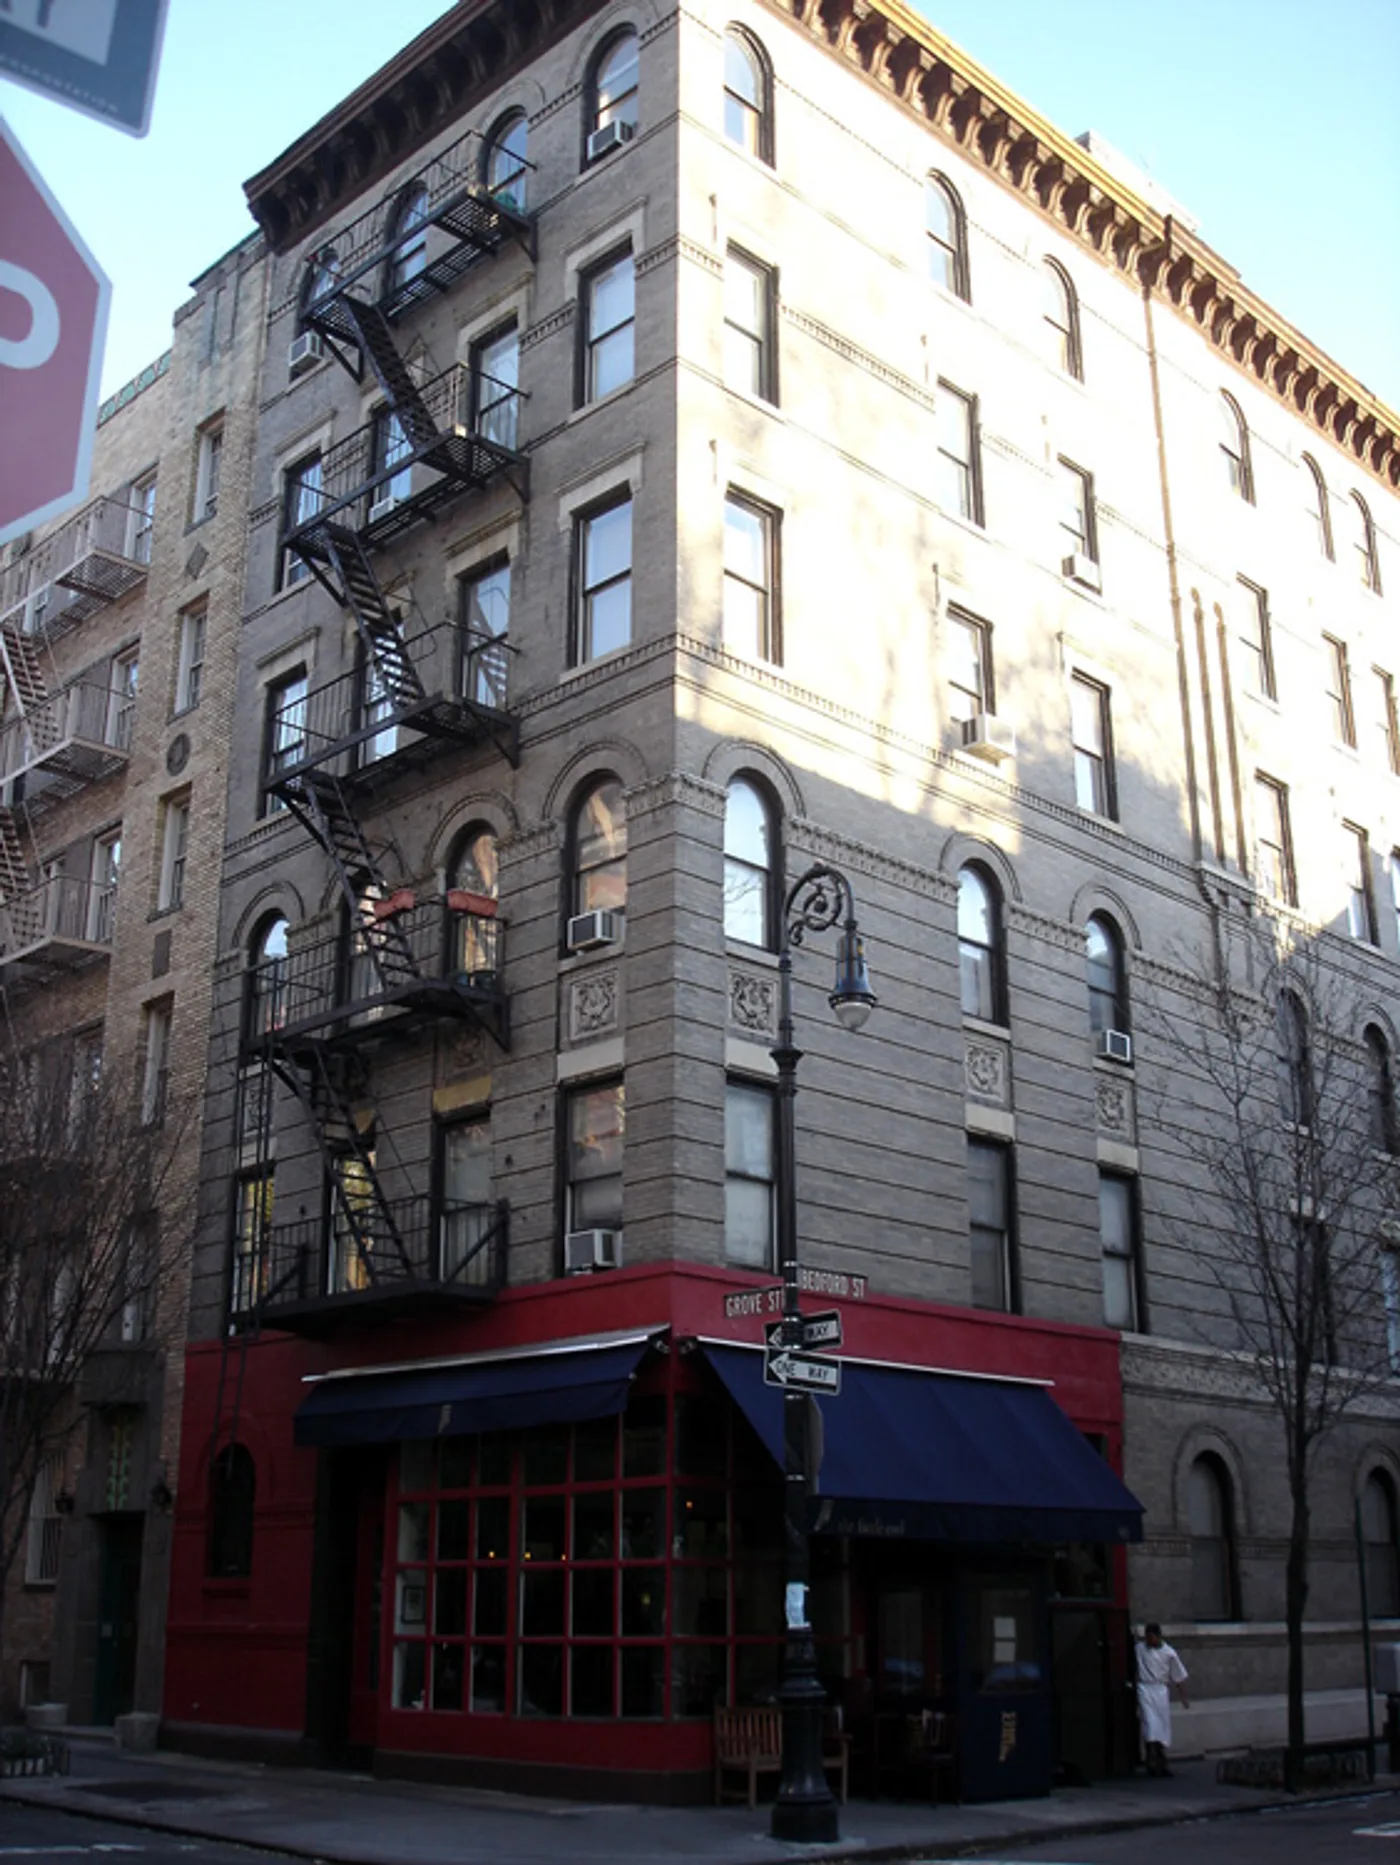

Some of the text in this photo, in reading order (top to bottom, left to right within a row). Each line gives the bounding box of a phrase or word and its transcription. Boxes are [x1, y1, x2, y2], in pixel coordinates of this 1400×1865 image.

[802, 1269, 864, 1298] BEDFORD ST
[726, 1292, 762, 1316] GROVE
[807, 1324, 829, 1339] WAY
[776, 1359, 829, 1381] ONE WAY
